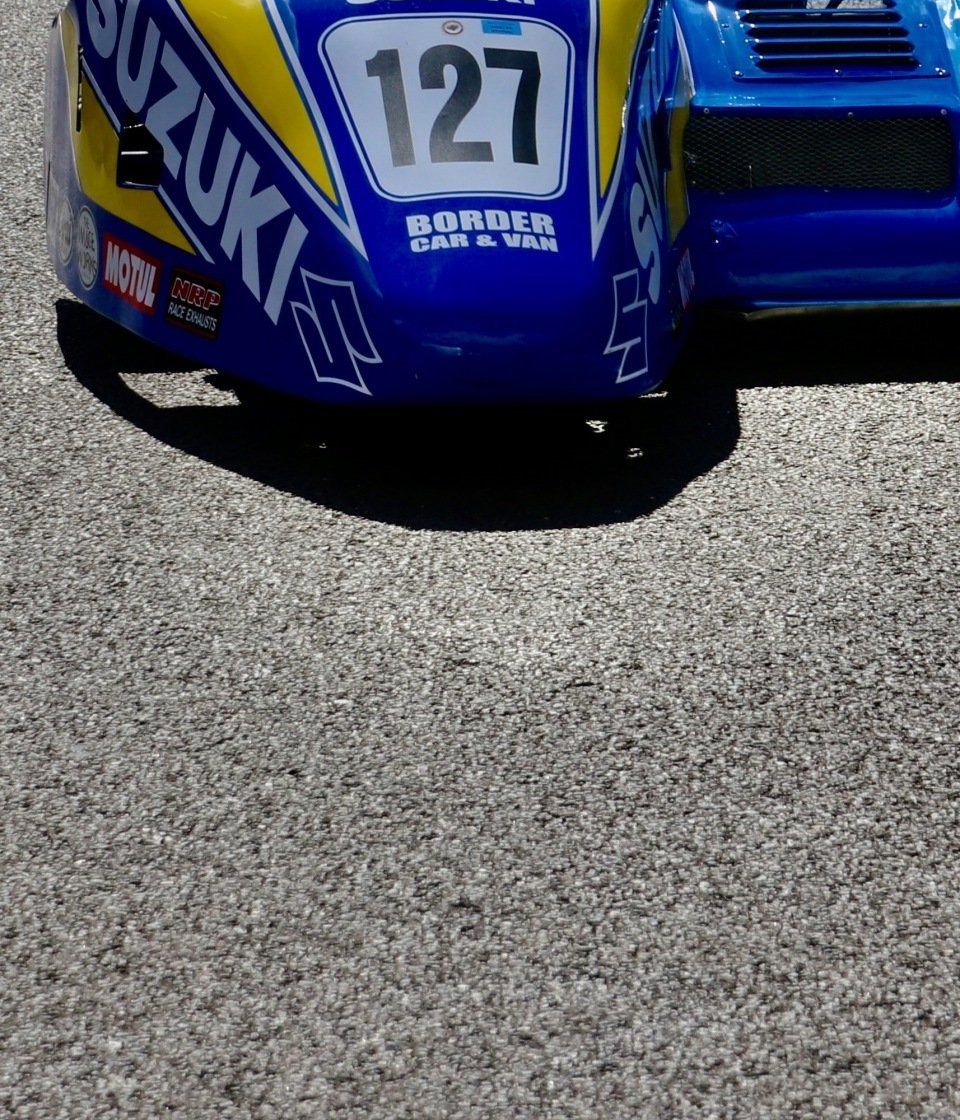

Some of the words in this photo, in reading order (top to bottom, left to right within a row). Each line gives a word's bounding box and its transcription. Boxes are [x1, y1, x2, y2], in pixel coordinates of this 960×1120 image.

[365, 44, 541, 168] 127
[406, 209, 556, 237] BORDER
[410, 233, 470, 253] CAR
[476, 234, 498, 248] &
[501, 232, 559, 253] VAN
[104, 240, 157, 308] MOTUL
[170, 276, 222, 311] NRP
[167, 301, 188, 320] RACE
[185, 309, 219, 333] EXHAUSTS
